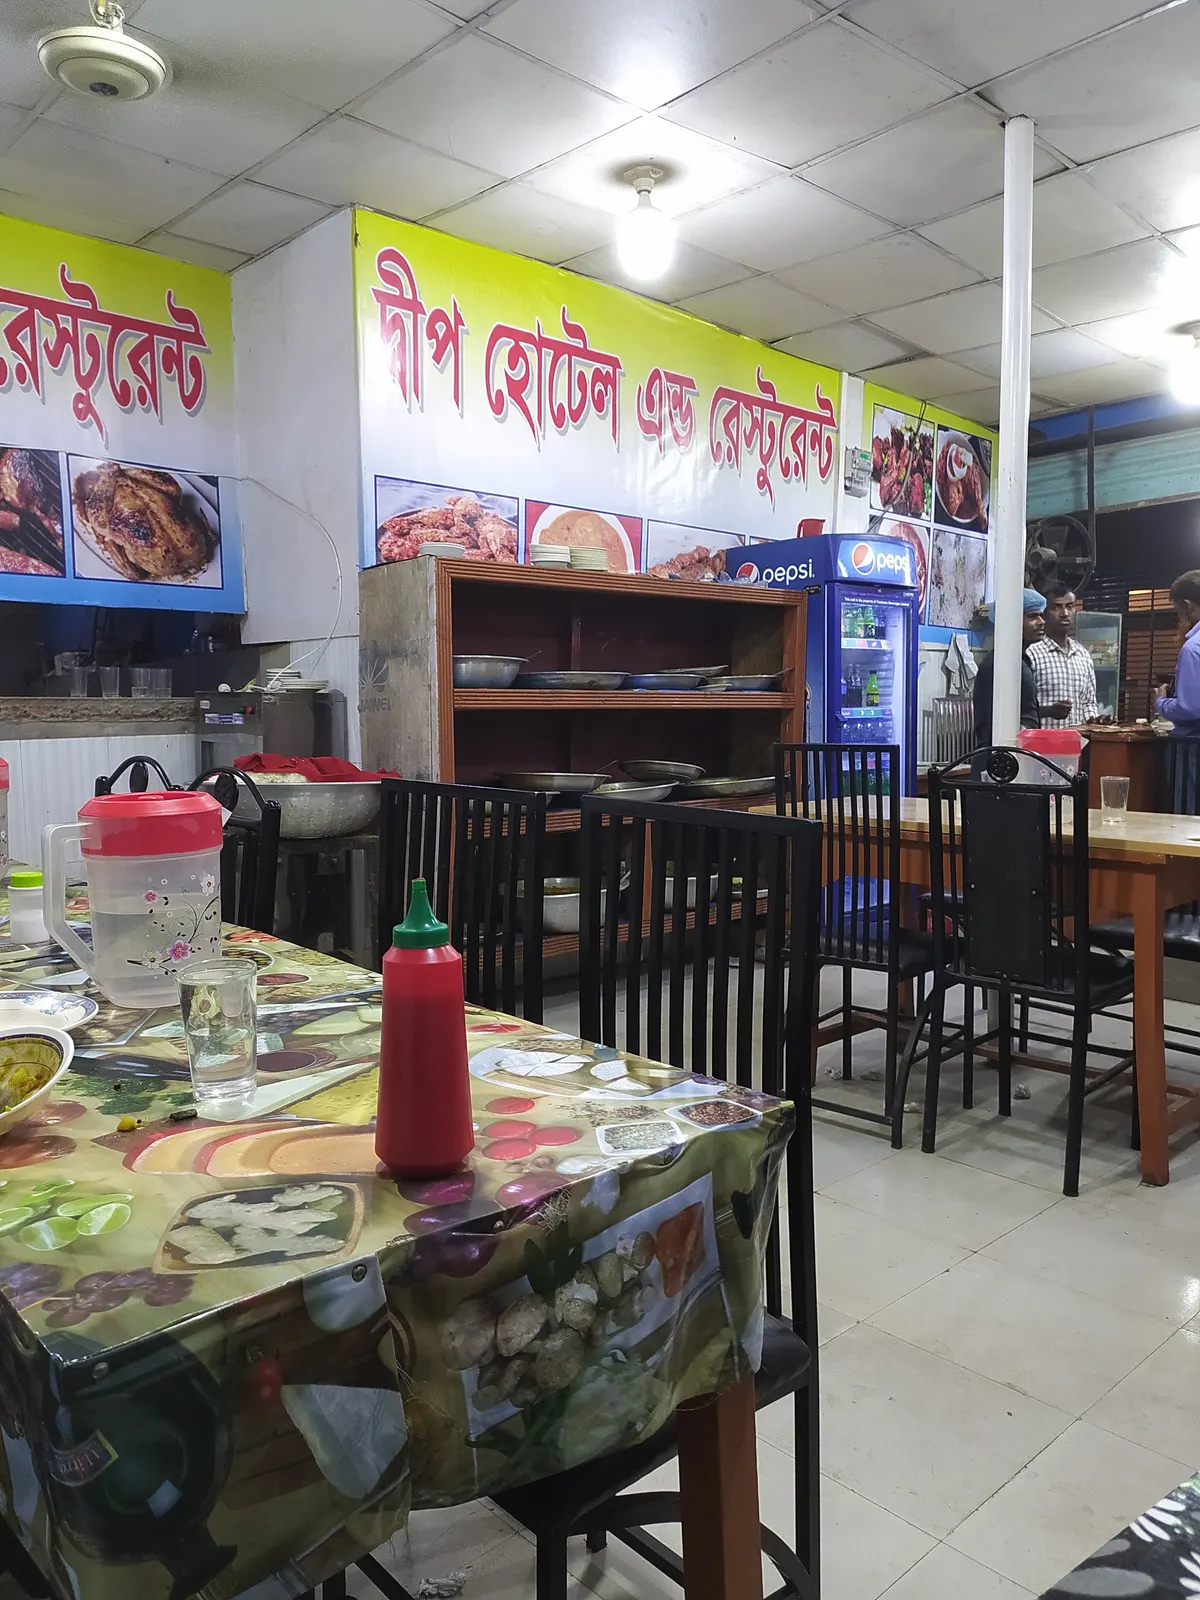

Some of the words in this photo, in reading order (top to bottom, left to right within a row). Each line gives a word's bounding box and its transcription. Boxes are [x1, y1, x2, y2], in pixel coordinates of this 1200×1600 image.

[485, 304, 624, 450] হোটেল
[708, 364, 838, 511] রেস্টুরেন্ট
[762, 558, 814, 586] pepsi
